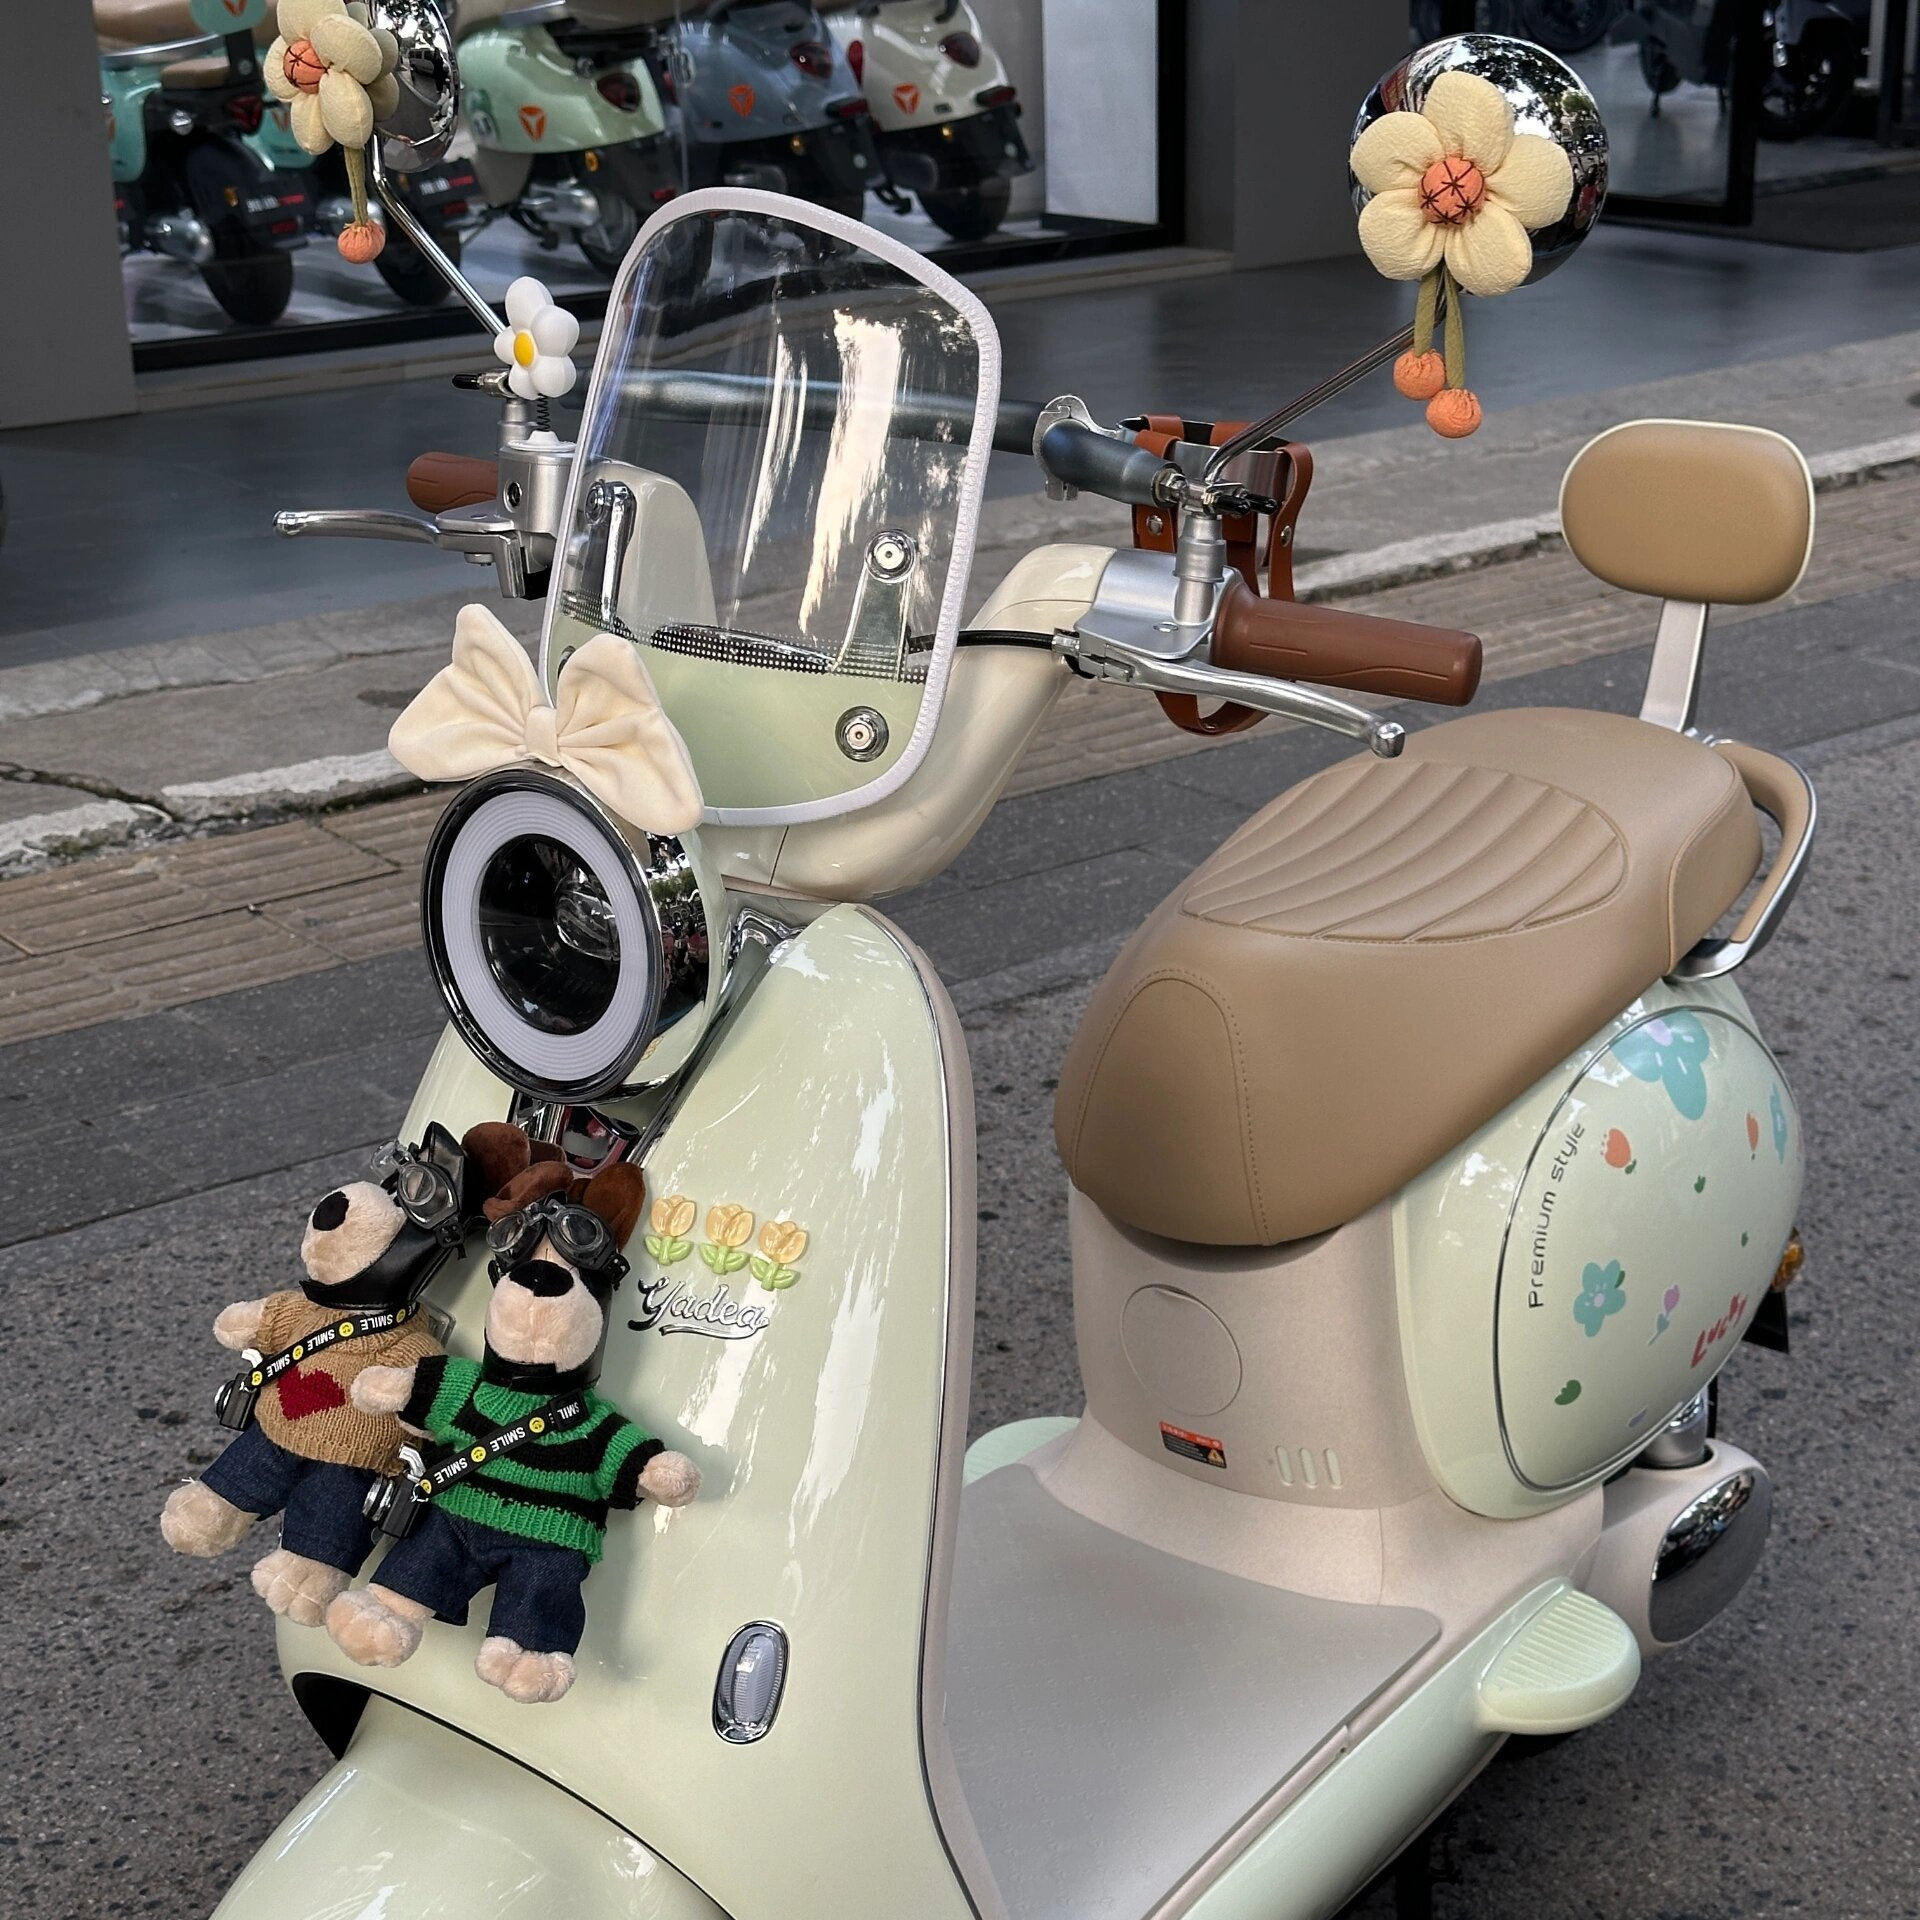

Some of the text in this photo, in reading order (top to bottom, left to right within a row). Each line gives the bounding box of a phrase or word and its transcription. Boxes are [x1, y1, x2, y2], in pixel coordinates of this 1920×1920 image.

[1528, 1122, 1586, 1309] Premium style
[628, 1276, 770, 1340] Yadea
[266, 1313, 394, 1378] SMILE SMILE SMILE
[433, 1457, 469, 1485] SMILE
[489, 1426, 526, 1453] SMILE
